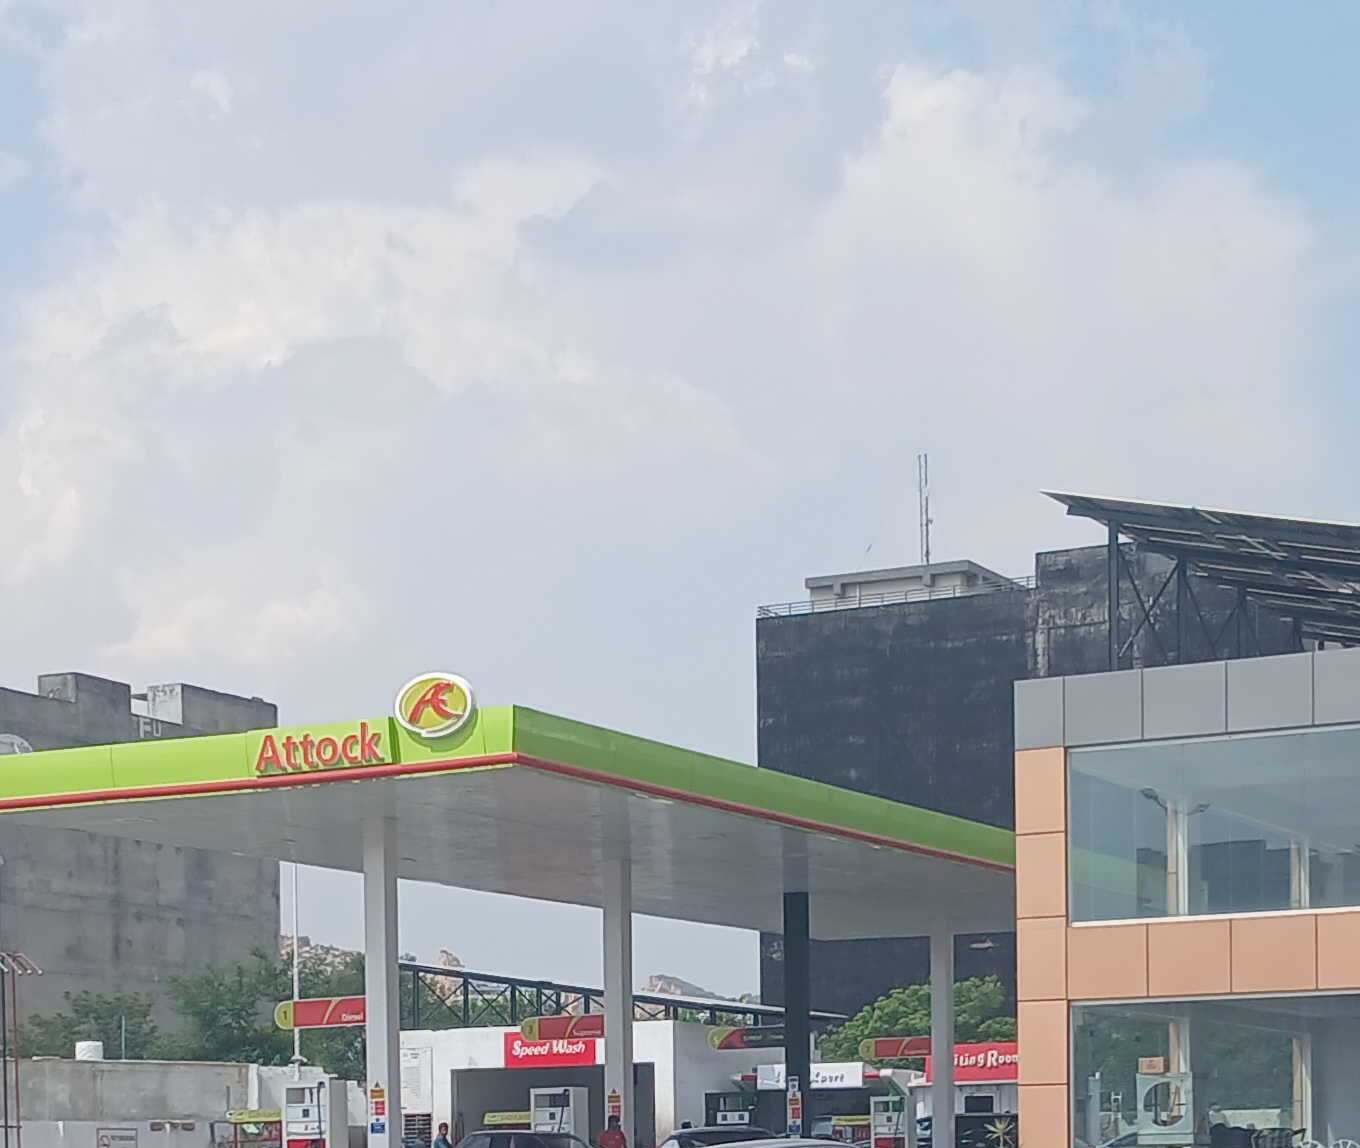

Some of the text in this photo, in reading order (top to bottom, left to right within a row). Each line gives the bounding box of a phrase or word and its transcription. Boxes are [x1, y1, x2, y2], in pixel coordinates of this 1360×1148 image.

[255, 721, 382, 772] Attock
[512, 1039, 586, 1059] Speed Wash
